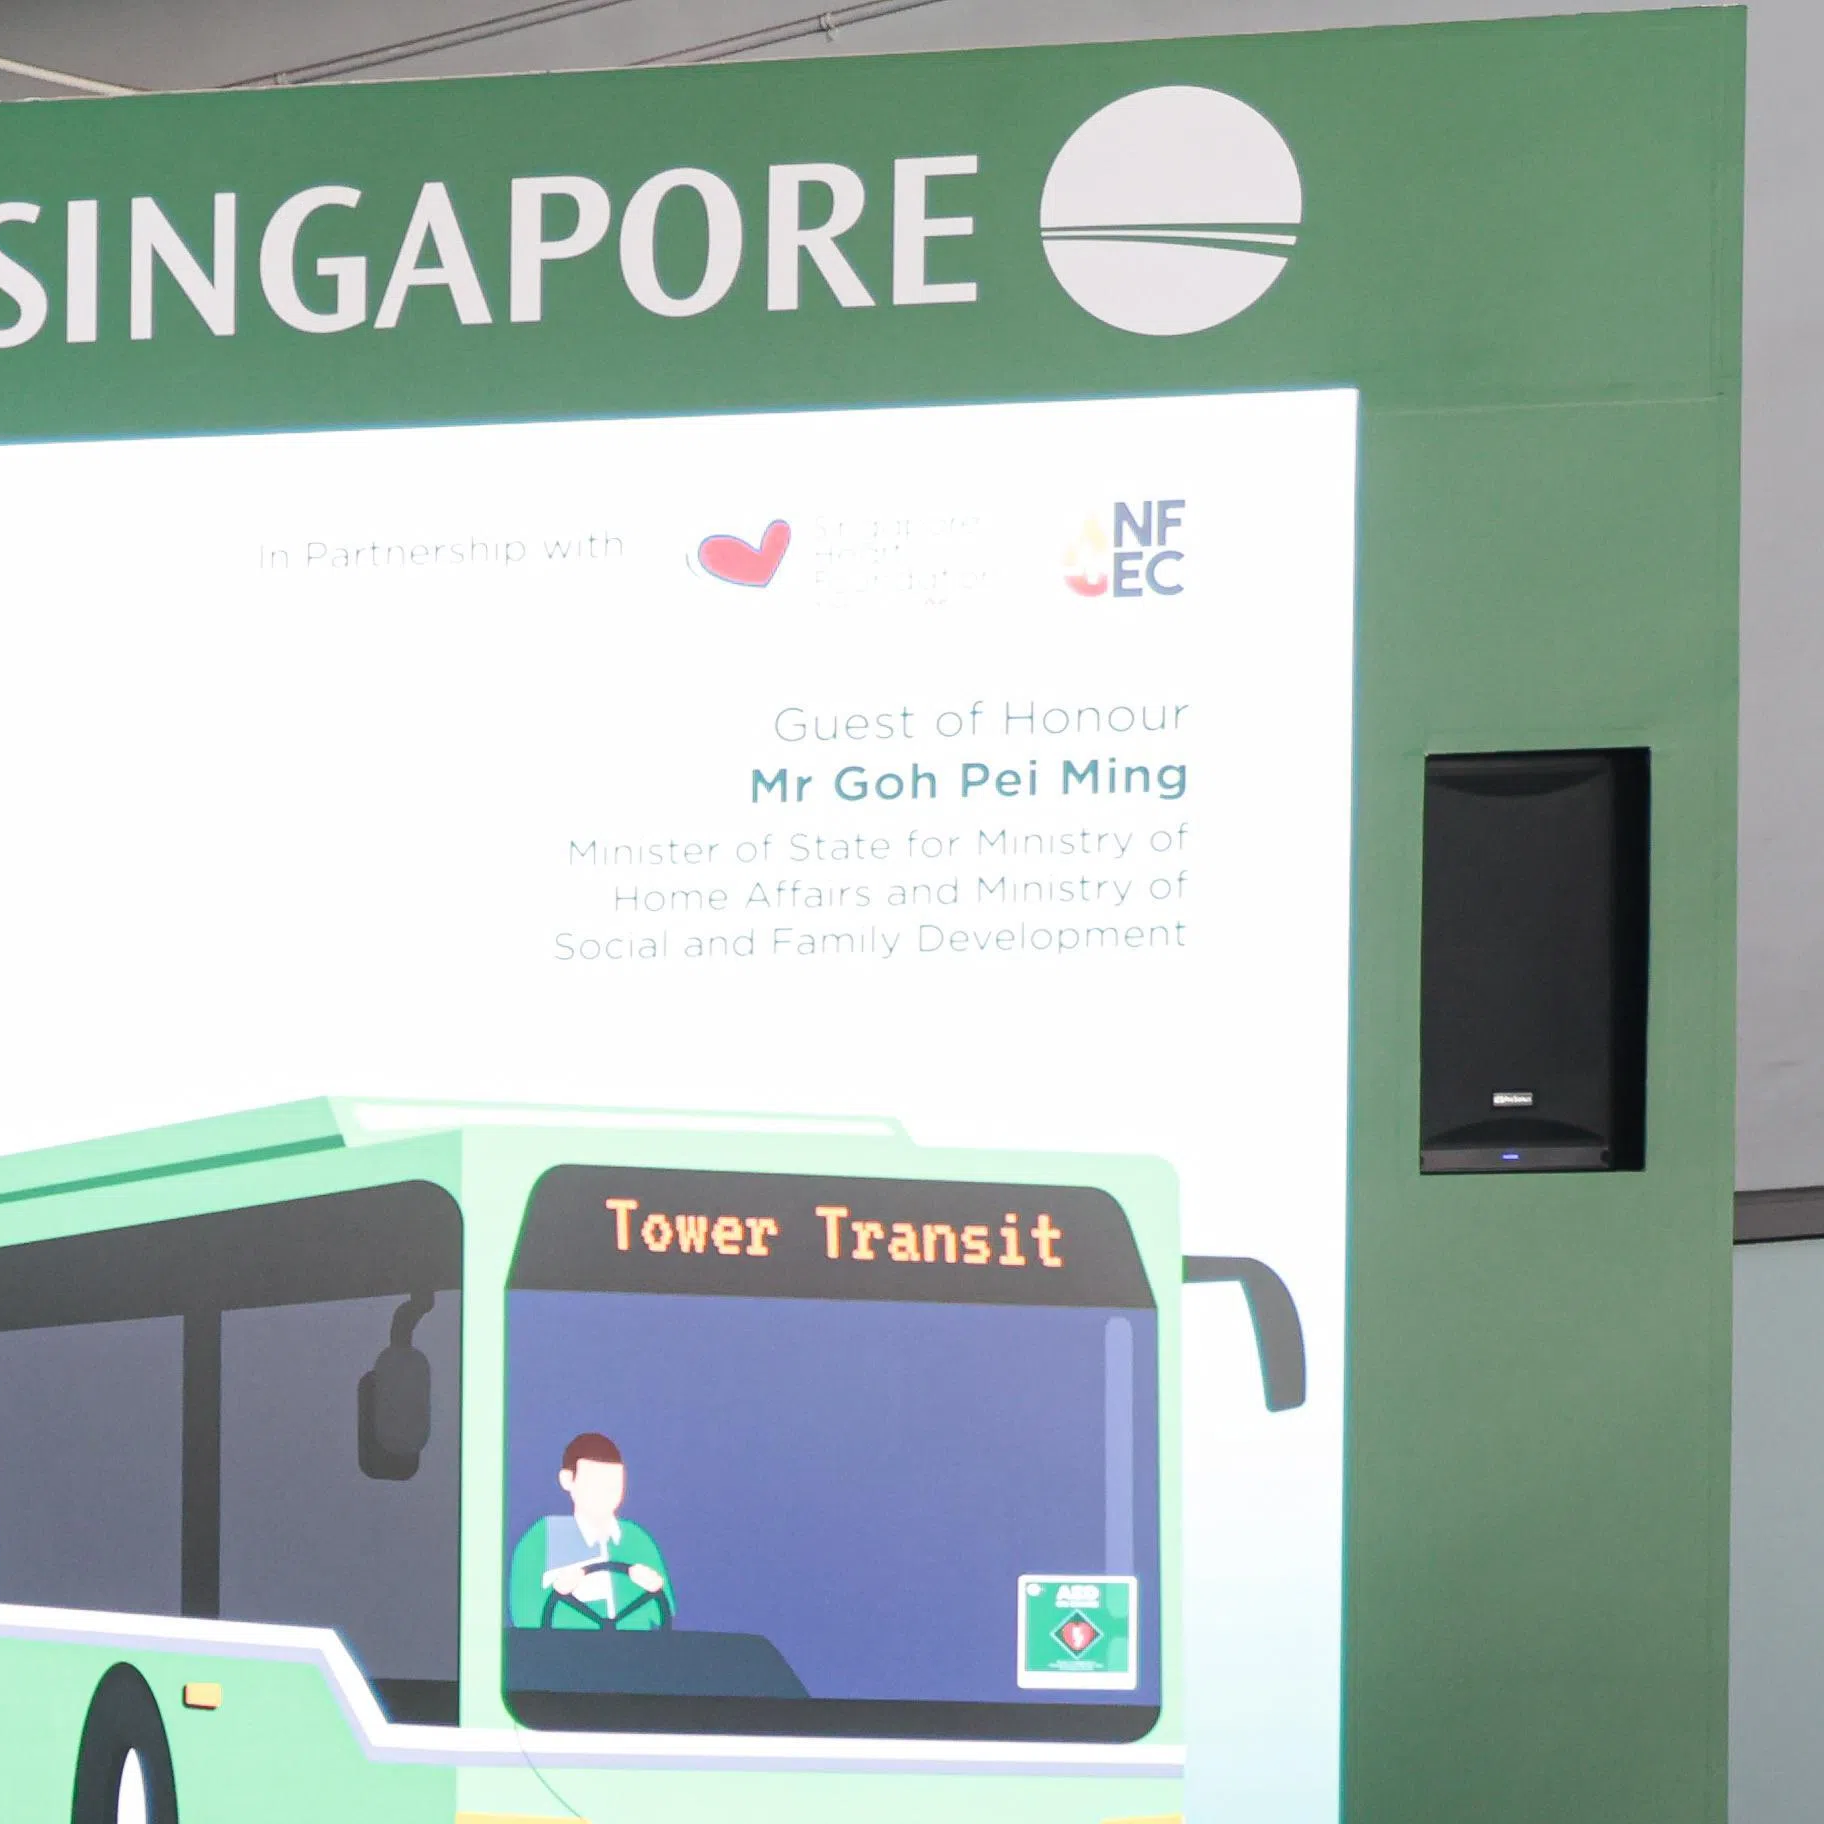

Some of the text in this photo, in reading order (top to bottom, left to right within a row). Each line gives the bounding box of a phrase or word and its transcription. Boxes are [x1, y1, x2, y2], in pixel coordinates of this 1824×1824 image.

[1113, 499, 1186, 548] NF
[260, 532, 623, 569] In Partnership with
[1112, 550, 1185, 598] EC
[774, 700, 1189, 742] Guest of Honour
[752, 757, 1186, 803] Mr Goh Pei Ming
[569, 822, 1188, 865] Minister of State for Ministry of
[616, 870, 1188, 911] Home Affairs and Ministry of
[554, 921, 1186, 960] Social and Family Development
[605, 1197, 1064, 1269] Tower Transit
